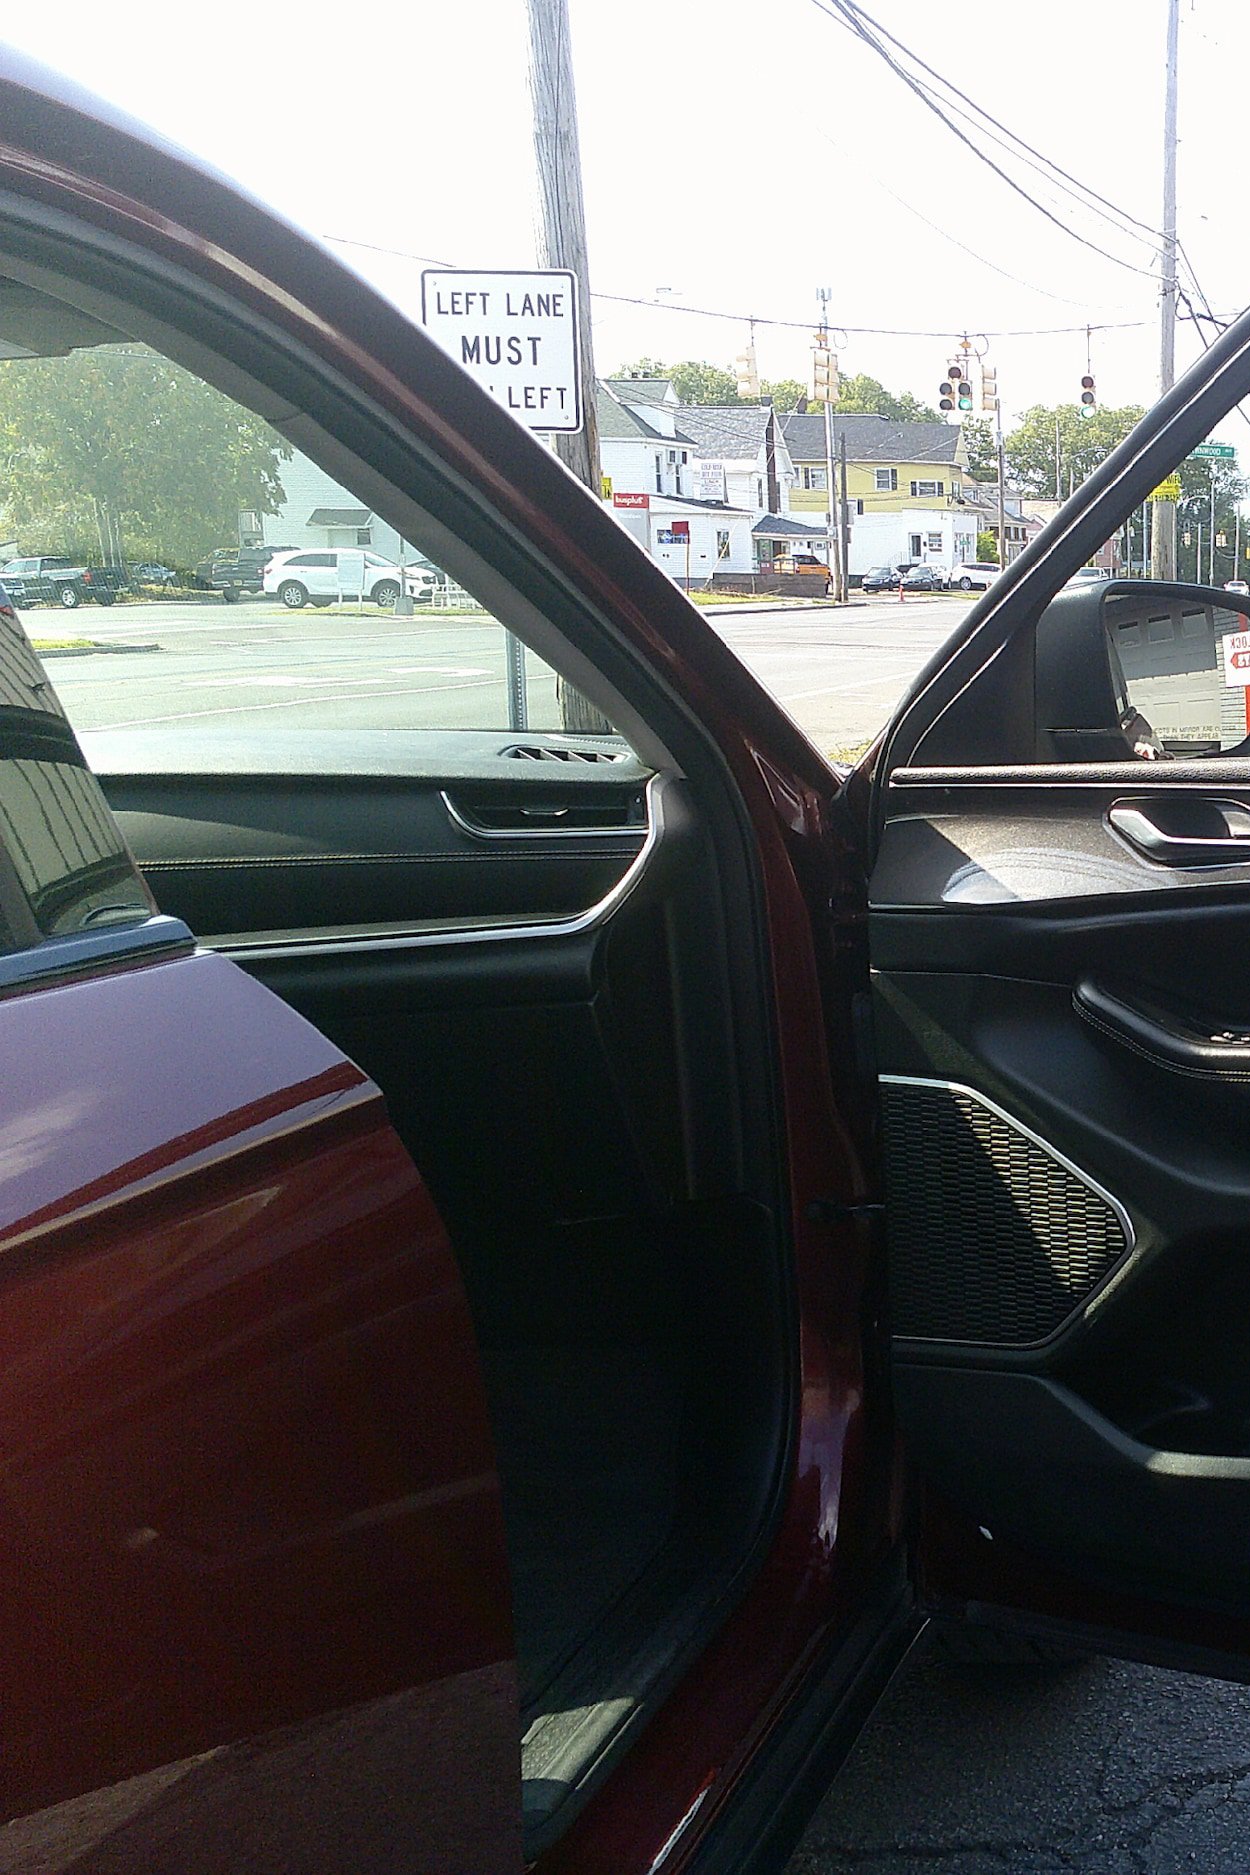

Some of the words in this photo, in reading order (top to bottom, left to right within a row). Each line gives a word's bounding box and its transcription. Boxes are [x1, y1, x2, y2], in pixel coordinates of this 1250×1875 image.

[436, 291, 490, 316] LEFT
[506, 292, 564, 317] LANE
[461, 335, 542, 366] MUST
[508, 386, 567, 409] LEFT
